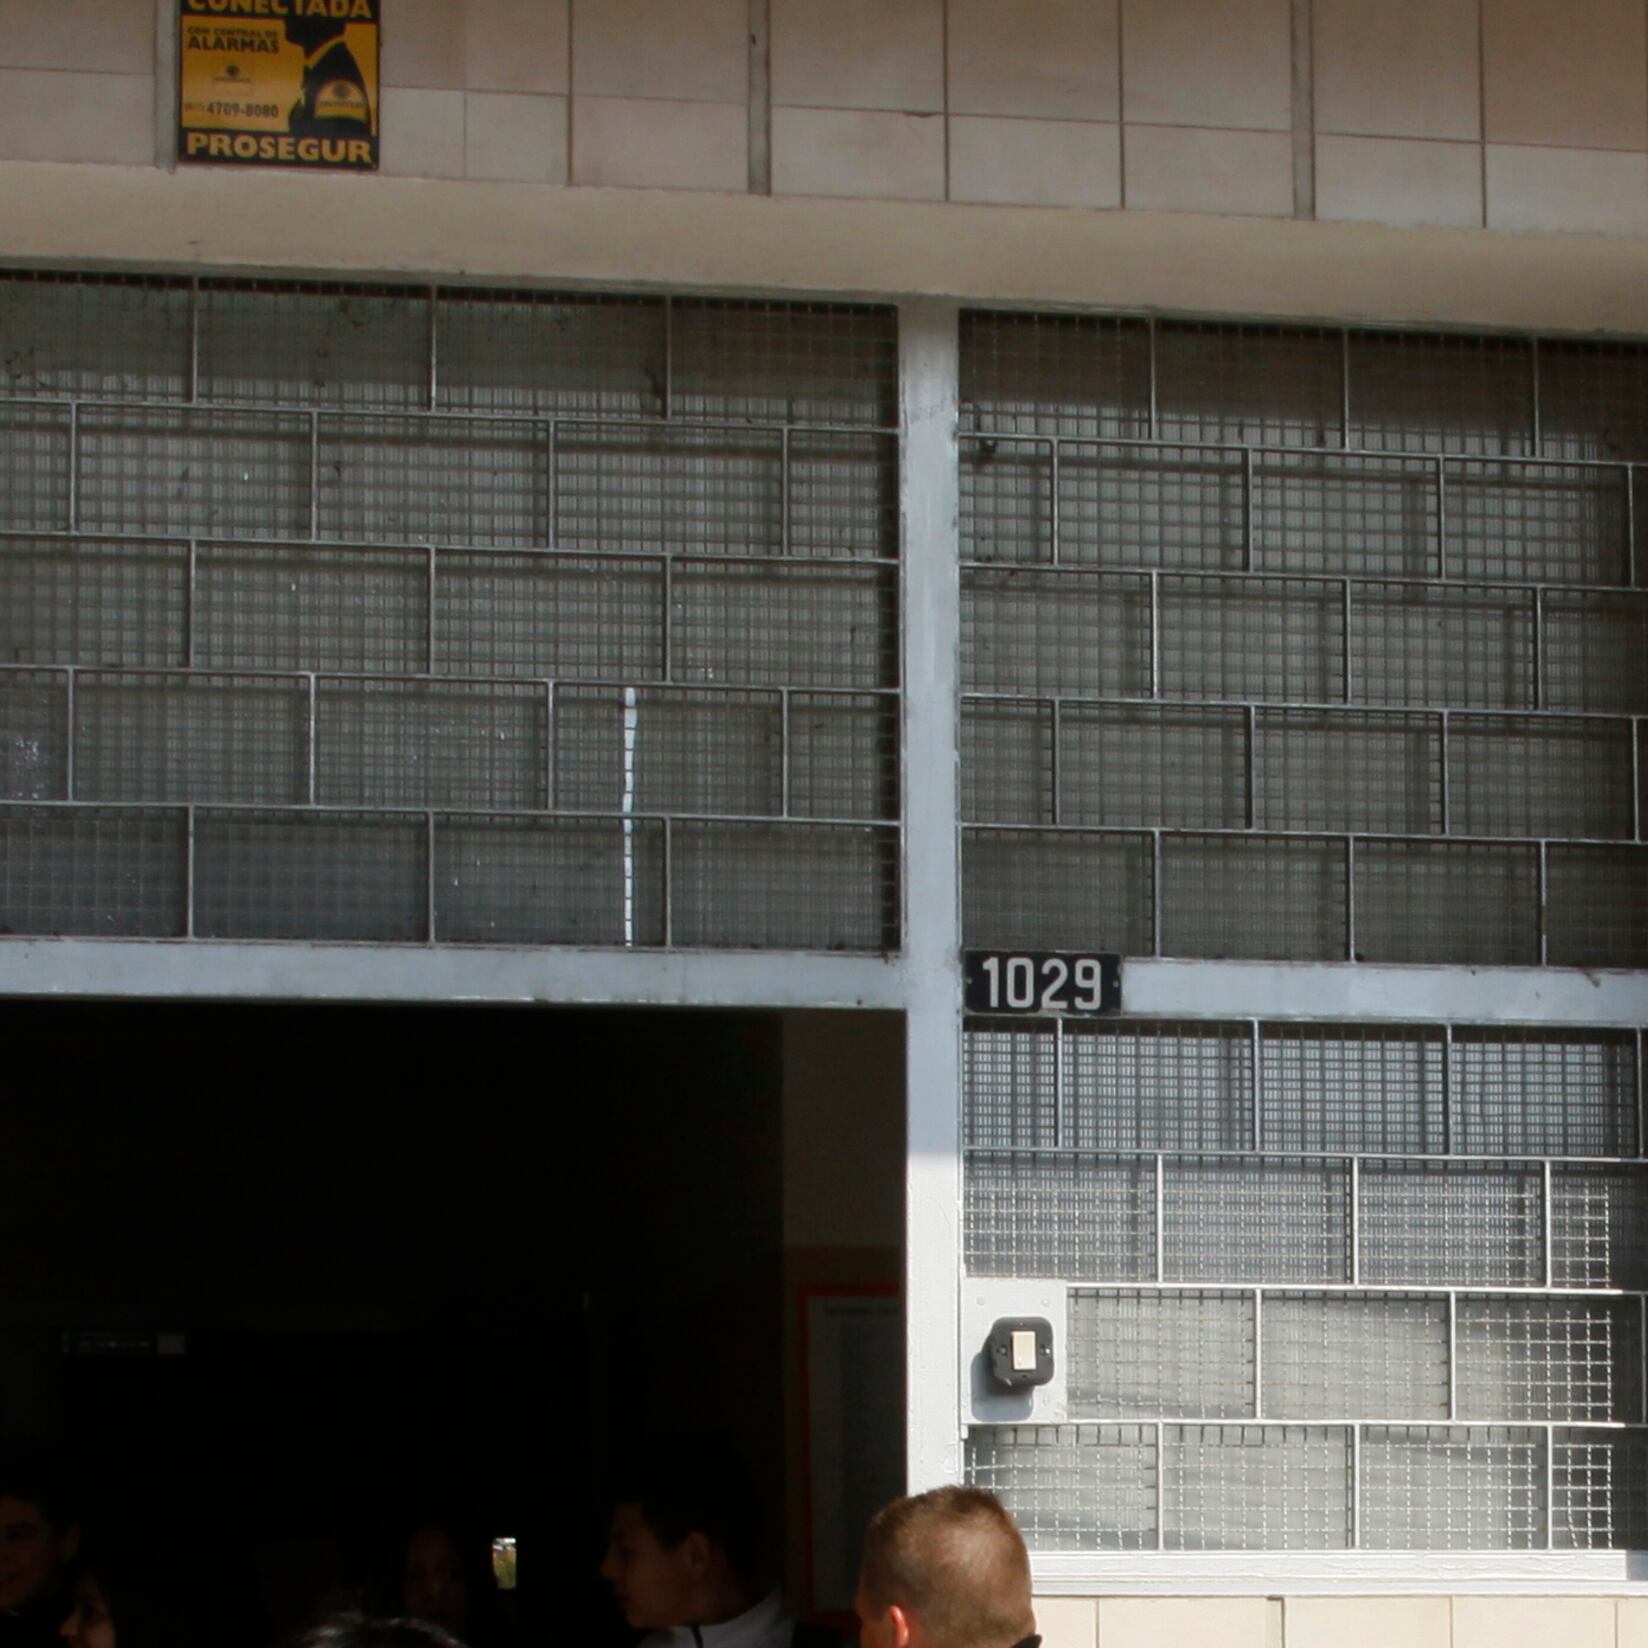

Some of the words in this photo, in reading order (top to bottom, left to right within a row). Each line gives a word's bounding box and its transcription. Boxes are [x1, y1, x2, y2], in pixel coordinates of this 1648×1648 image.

[188, 35, 279, 53] ALARMAS
[187, 132, 372, 163] PROSEGUR
[982, 956, 1102, 1010] 1029
